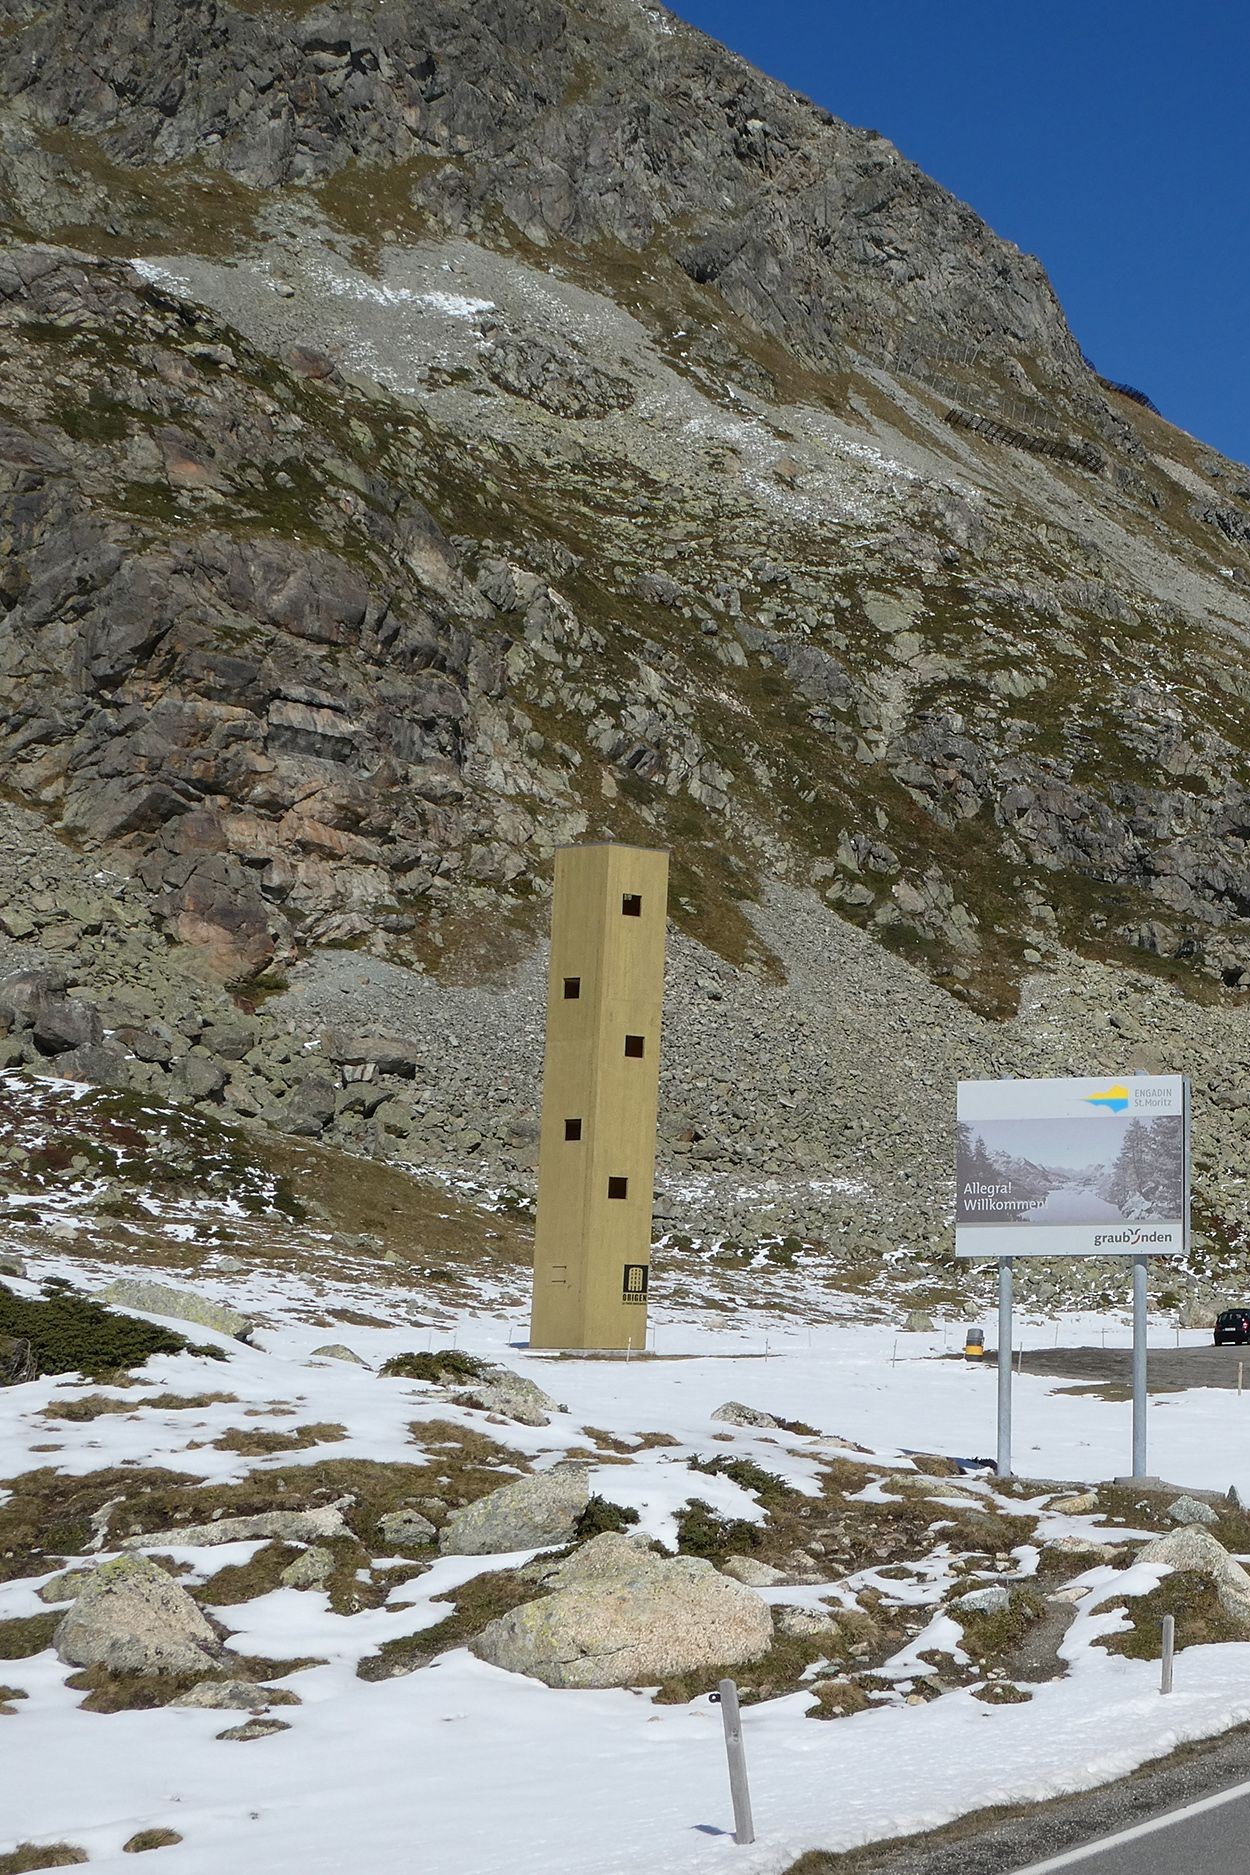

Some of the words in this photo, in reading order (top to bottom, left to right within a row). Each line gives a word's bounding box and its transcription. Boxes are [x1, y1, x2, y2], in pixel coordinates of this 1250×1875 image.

[1134, 1088, 1172, 1097] ENGADIN
[963, 1181, 1012, 1198] Allegra!
[622, 1293, 647, 1302] ORIGEN
